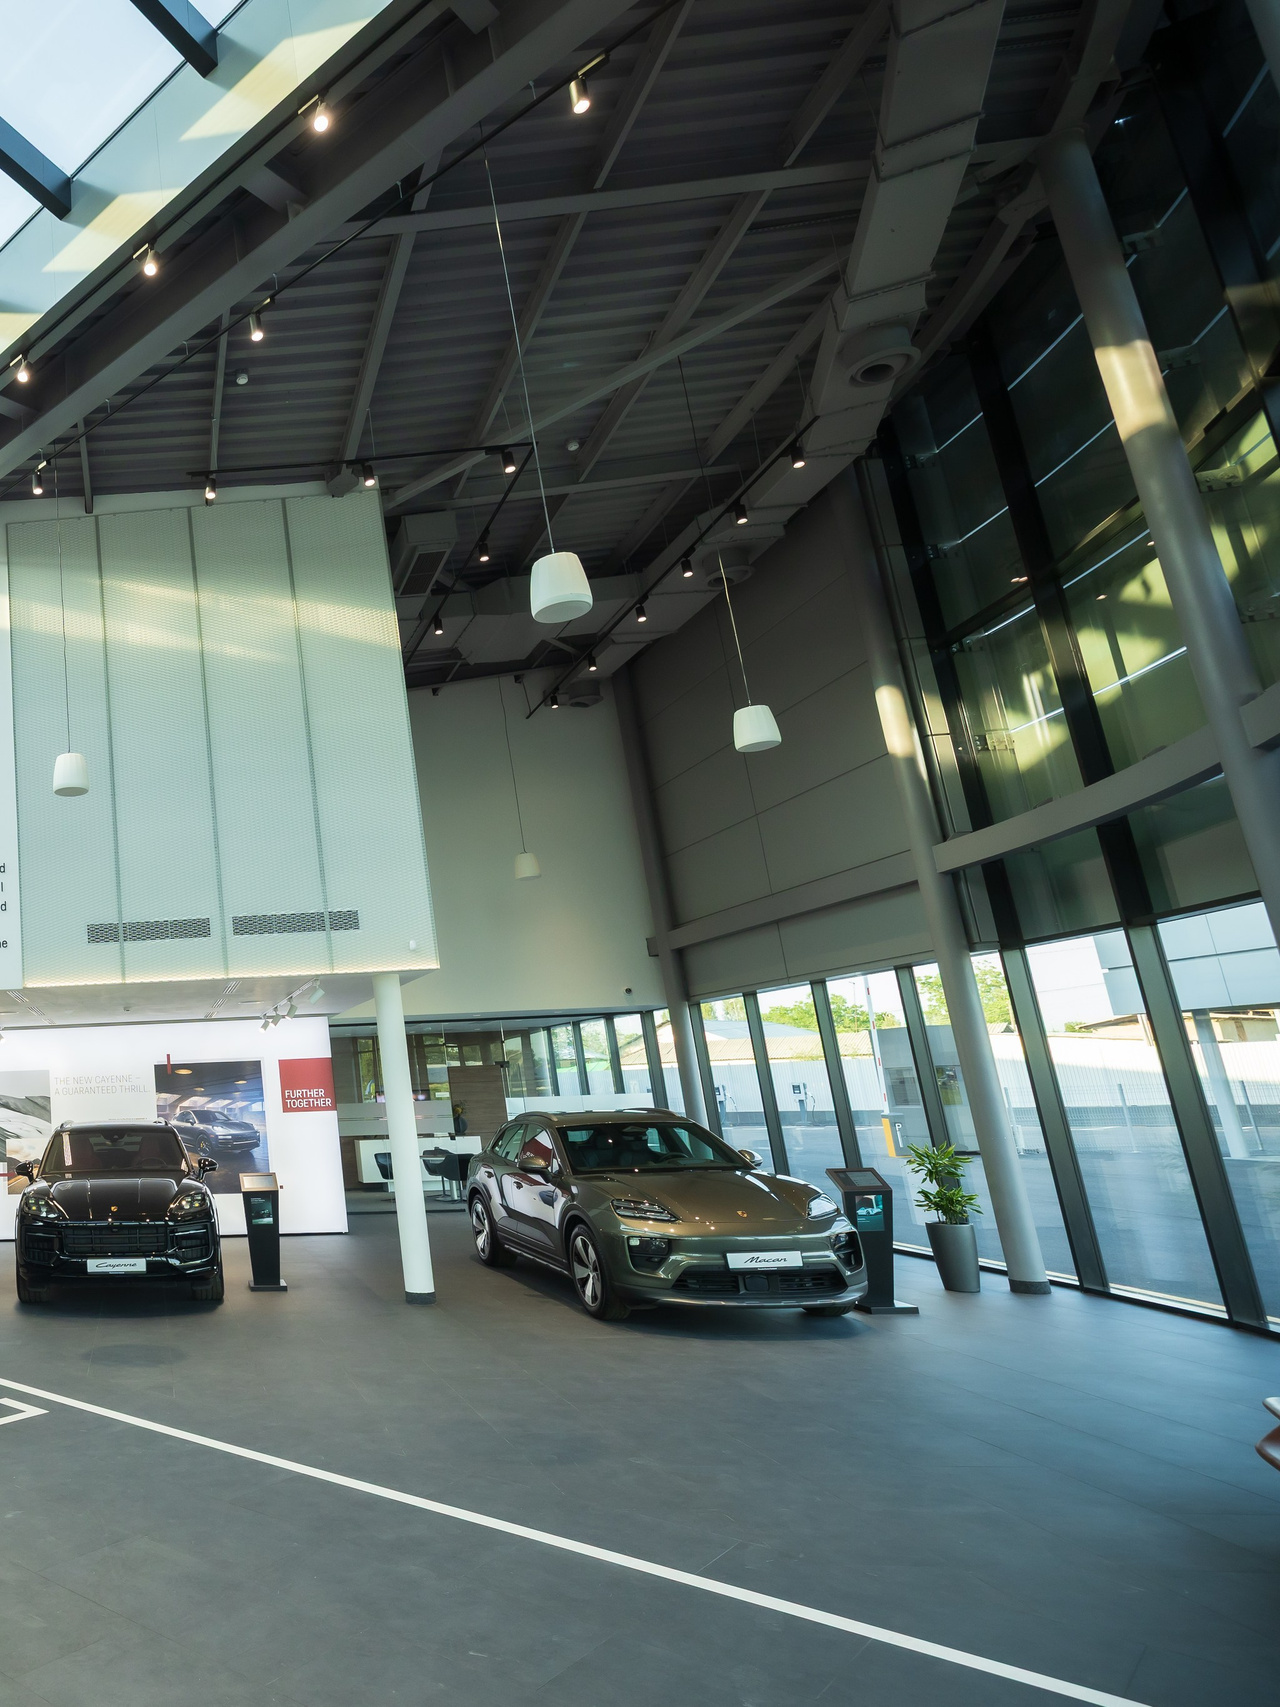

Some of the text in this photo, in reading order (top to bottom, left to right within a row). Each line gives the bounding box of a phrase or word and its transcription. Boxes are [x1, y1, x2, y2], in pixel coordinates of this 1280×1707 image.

[54, 1077, 70, 1086] THE
[72, 1076, 93, 1085] NEW
[94, 1074, 133, 1084] CAYENNE
[54, 1084, 151, 1096] A GUARANTEED THRILL.
[285, 1088, 325, 1098] FURTHER
[285, 1098, 332, 1108] TOGETHER
[95, 1261, 138, 1269] Cayenne
[743, 1256, 788, 1264] Macan
